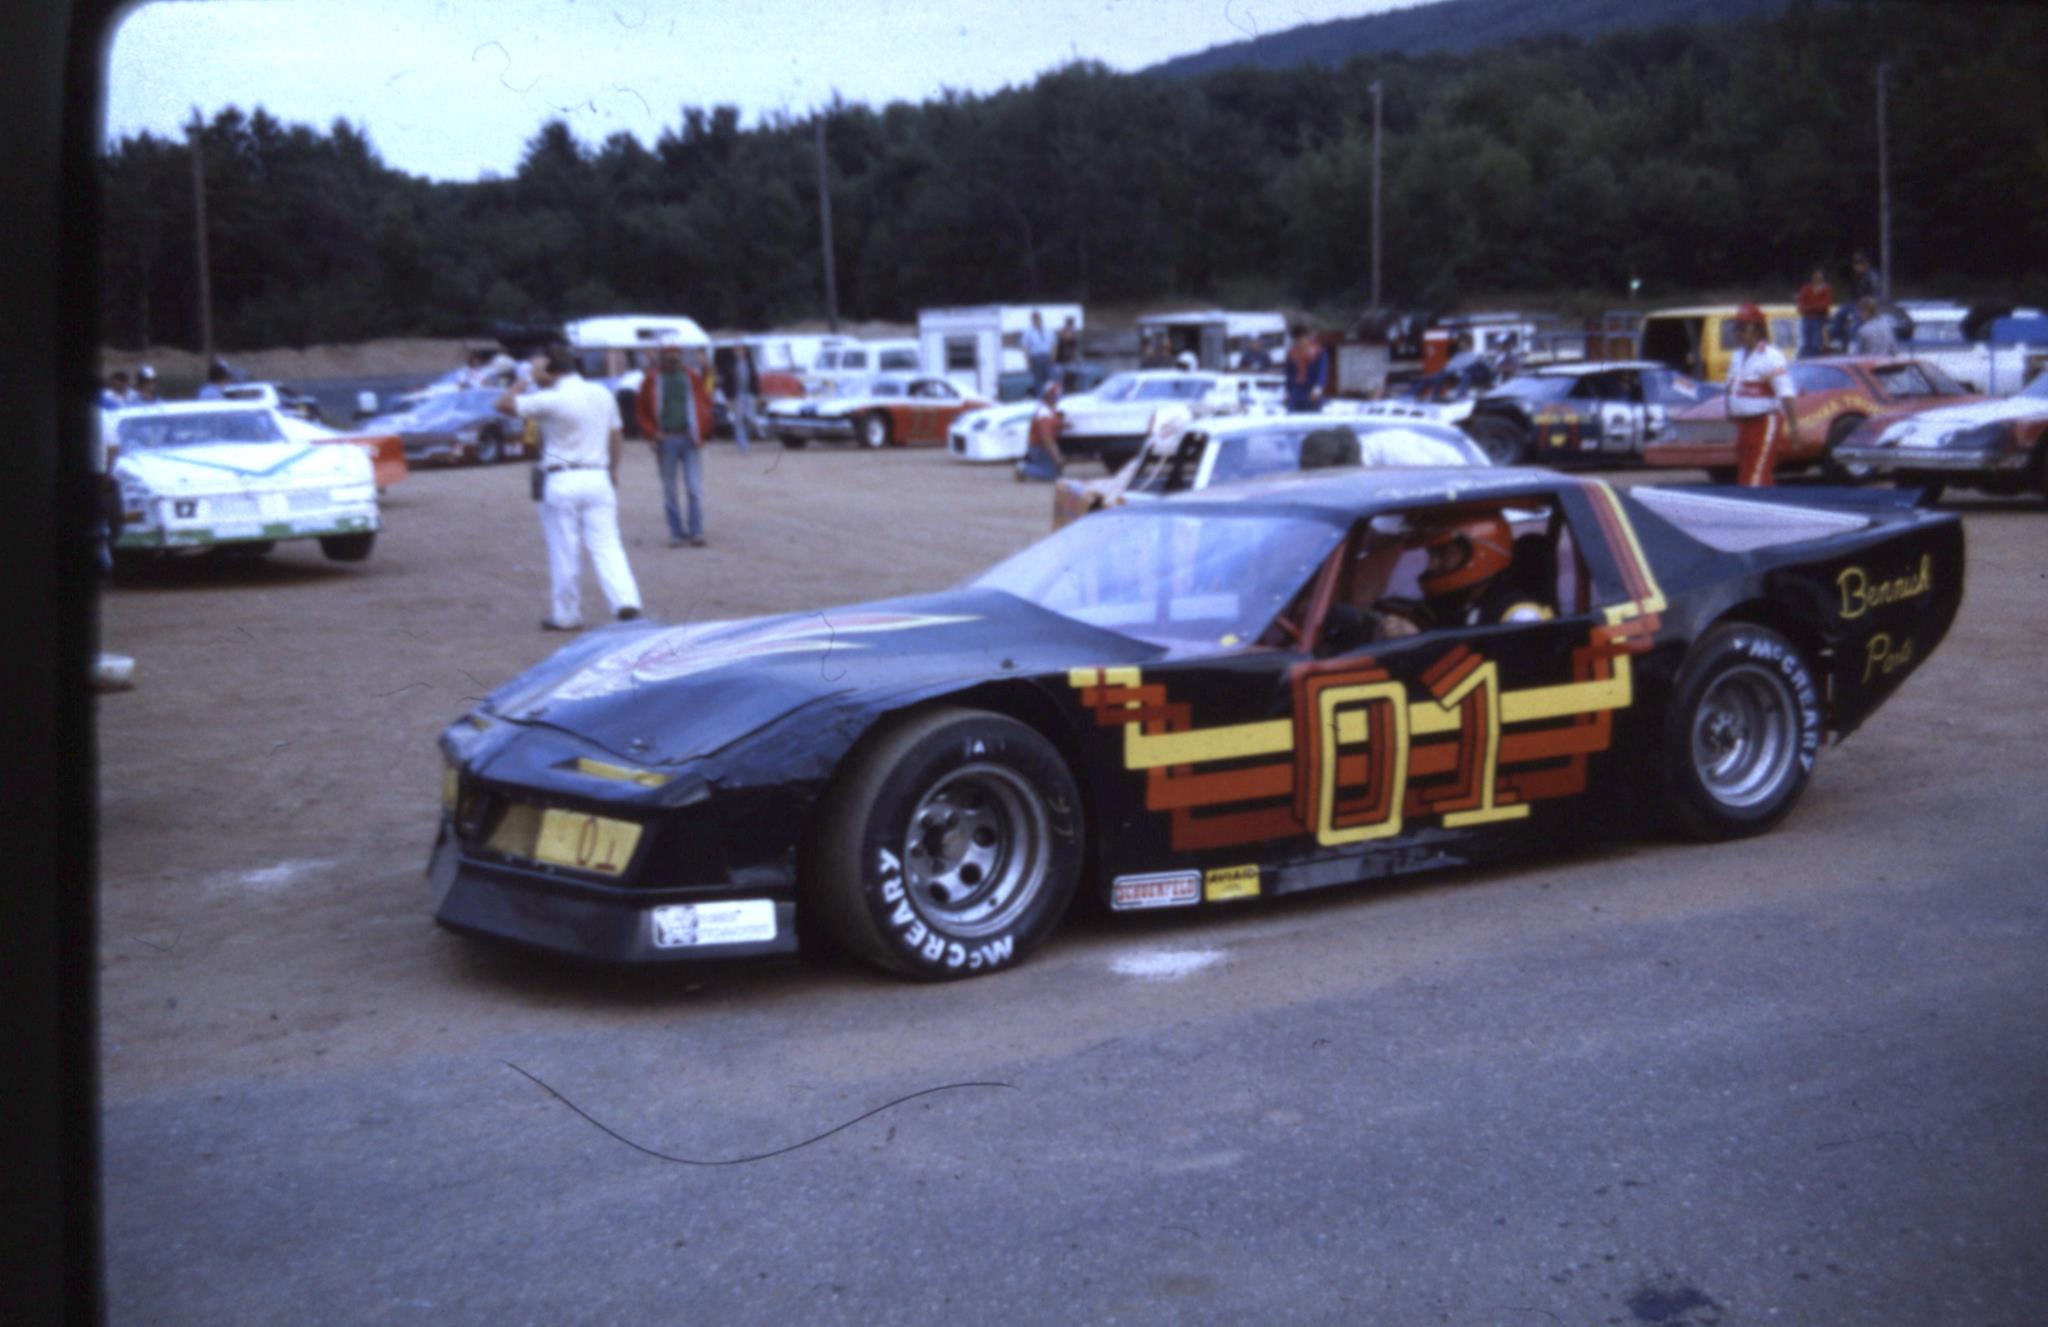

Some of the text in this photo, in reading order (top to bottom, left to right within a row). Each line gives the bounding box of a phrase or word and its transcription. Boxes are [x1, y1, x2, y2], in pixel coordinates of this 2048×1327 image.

[1317, 660, 1531, 847] 01
[575, 815, 618, 872] 01
[878, 847, 1015, 970] McCREARY
